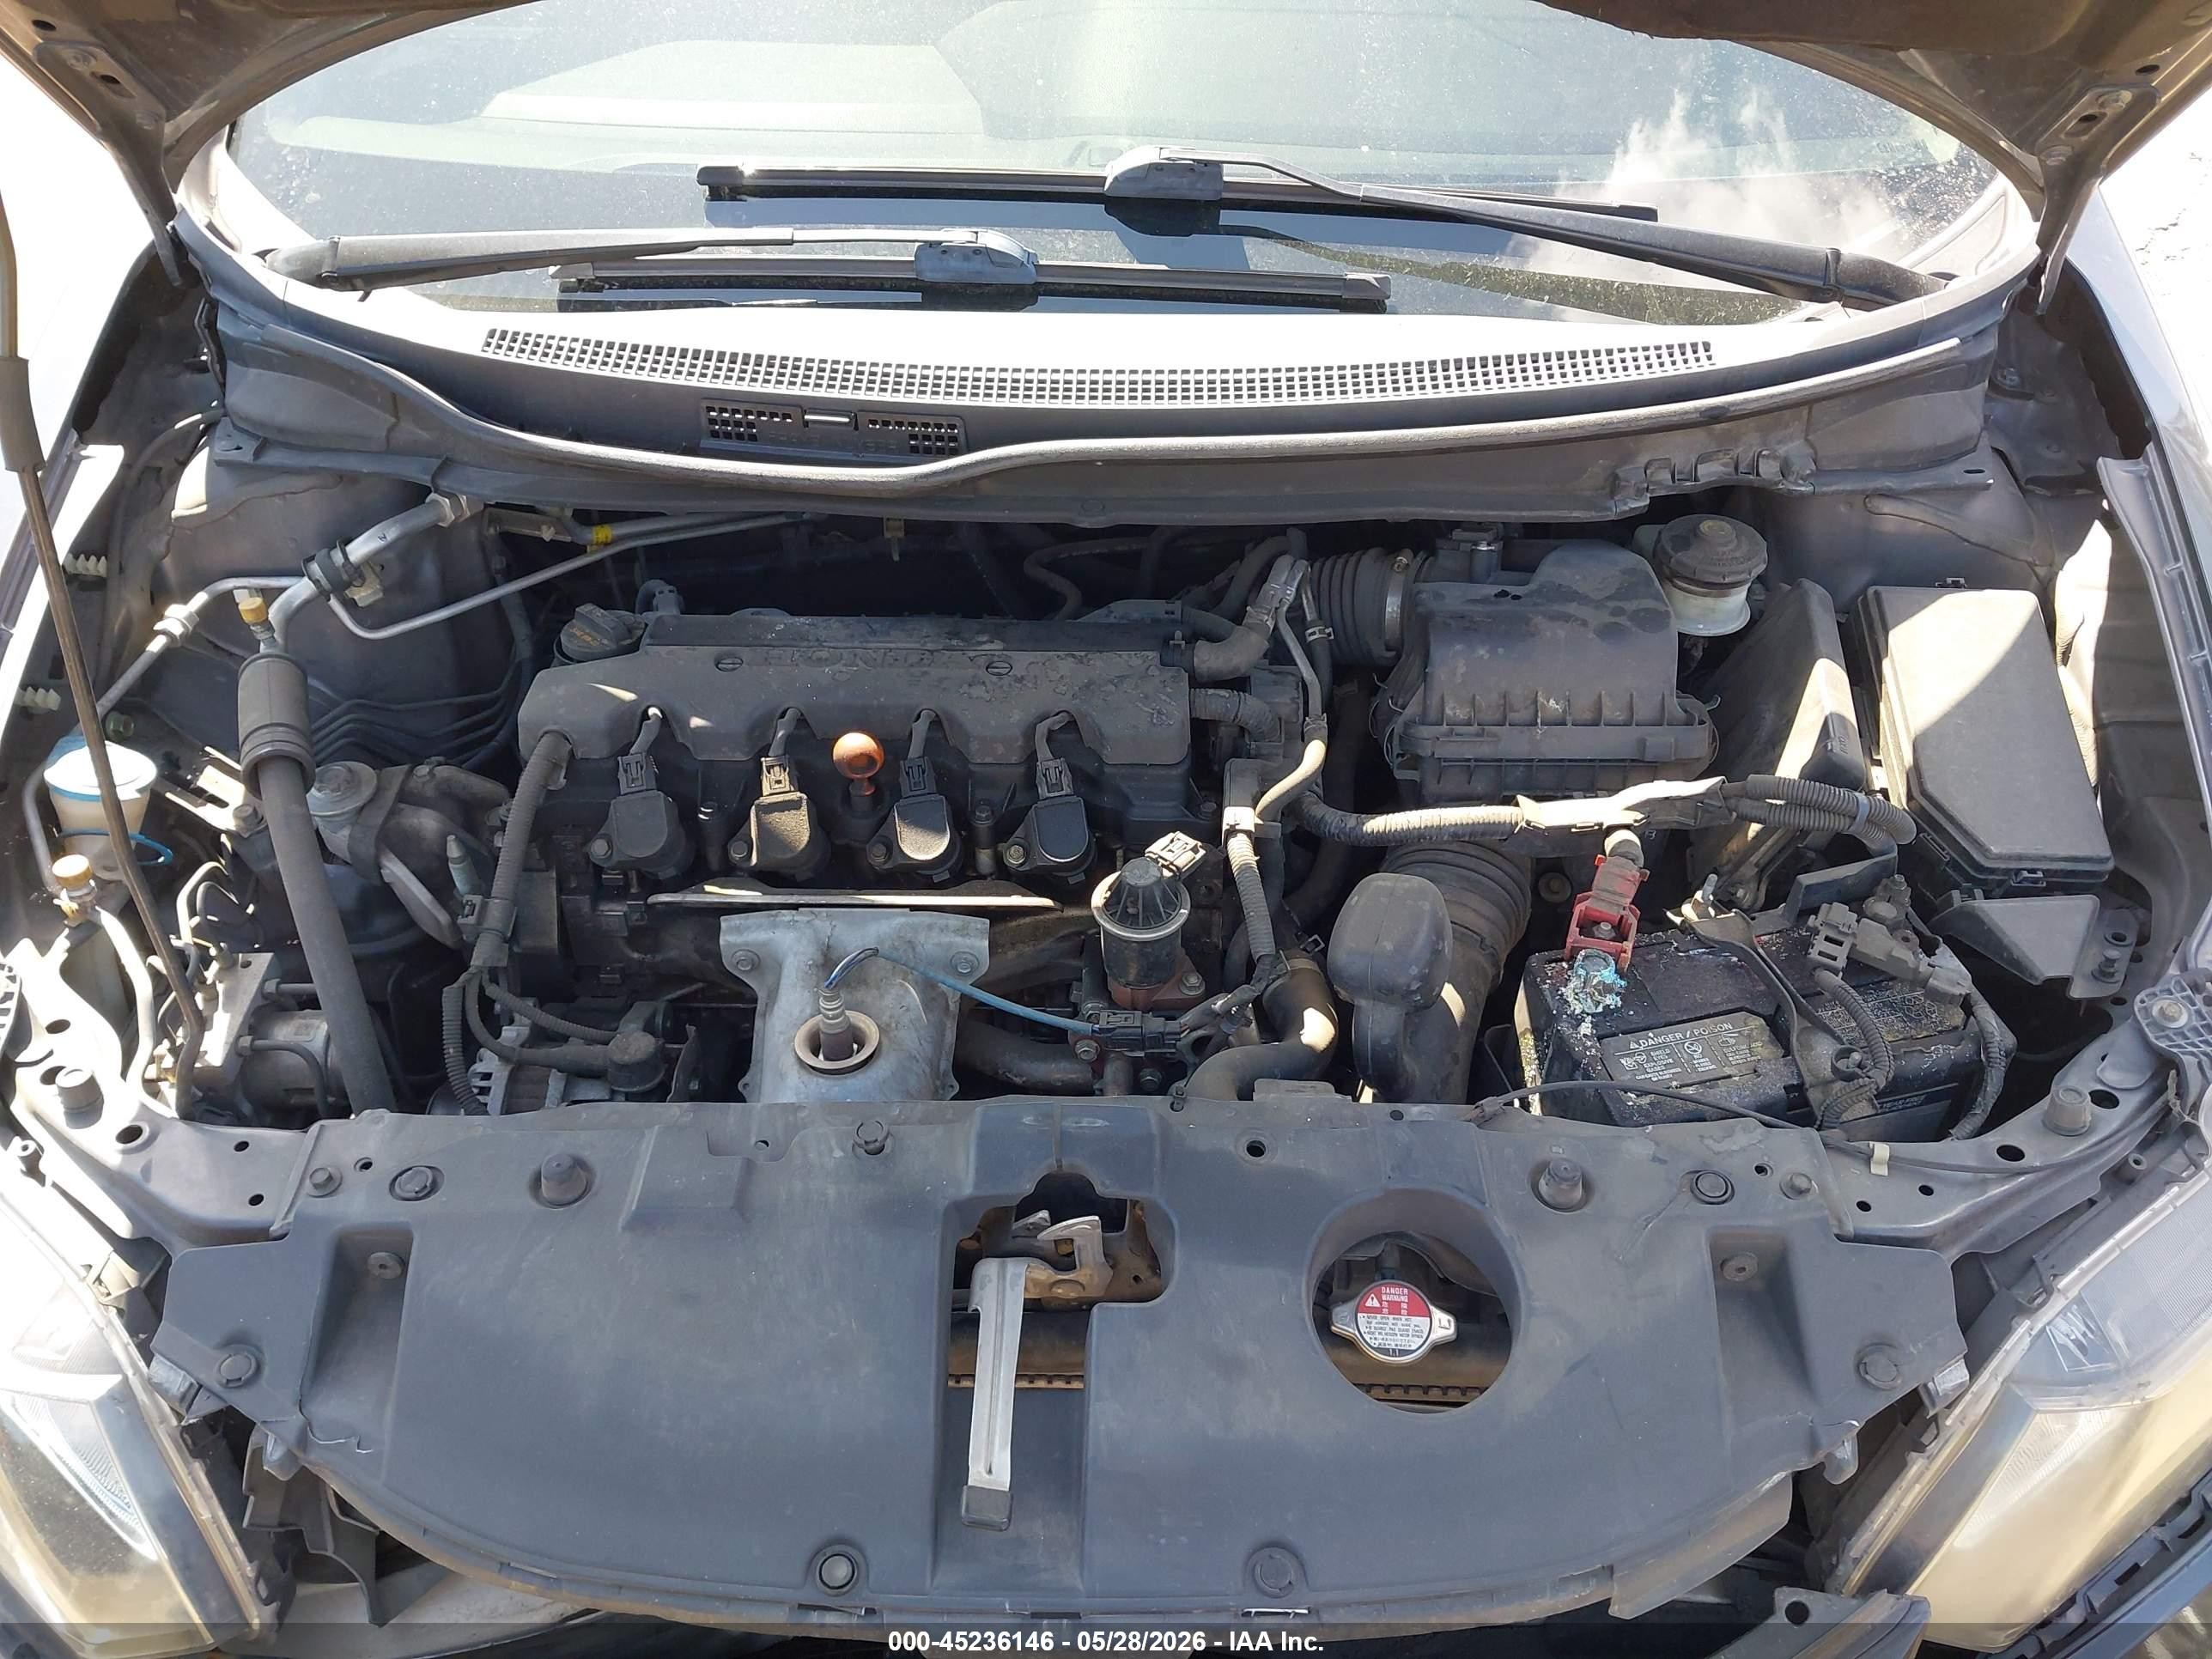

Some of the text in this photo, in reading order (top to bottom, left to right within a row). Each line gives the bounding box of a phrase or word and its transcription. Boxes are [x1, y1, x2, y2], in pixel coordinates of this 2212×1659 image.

[1639, 1032, 1684, 1048] DANGER
[1693, 1022, 1733, 1036] POISON
[1381, 1286, 1408, 1295] DANGER
